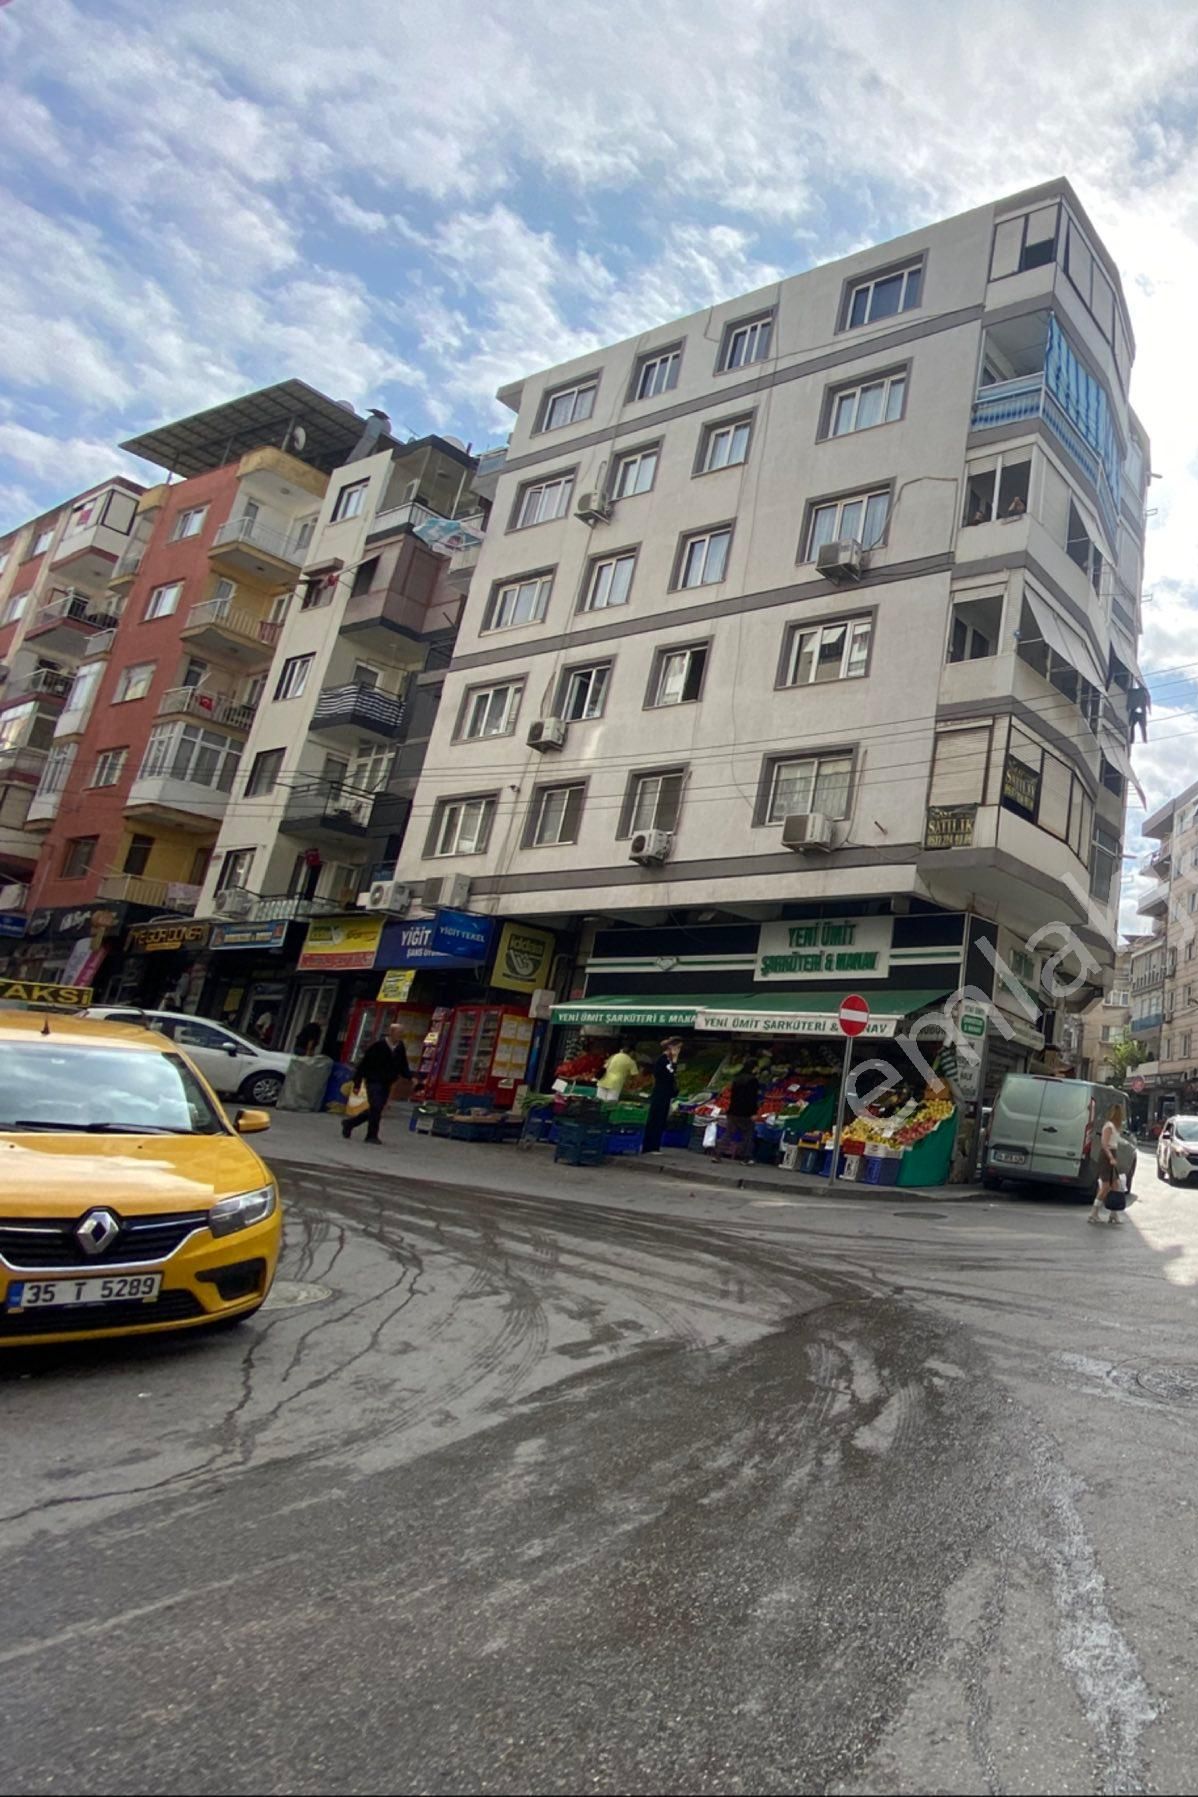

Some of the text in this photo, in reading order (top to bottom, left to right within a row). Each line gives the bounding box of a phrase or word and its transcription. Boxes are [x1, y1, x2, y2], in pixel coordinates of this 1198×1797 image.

[401, 926, 432, 946] YİĞİT
[788, 920, 858, 948] YENİ ÜMİT
[704, 1016, 728, 1028] YENİ
[732, 1016, 760, 1029] ÜMİT
[763, 1018, 826, 1031] ŞARKÜTERİ
[830, 1022, 839, 1032] &
[27, 1277, 155, 1304] 35 T 5289
